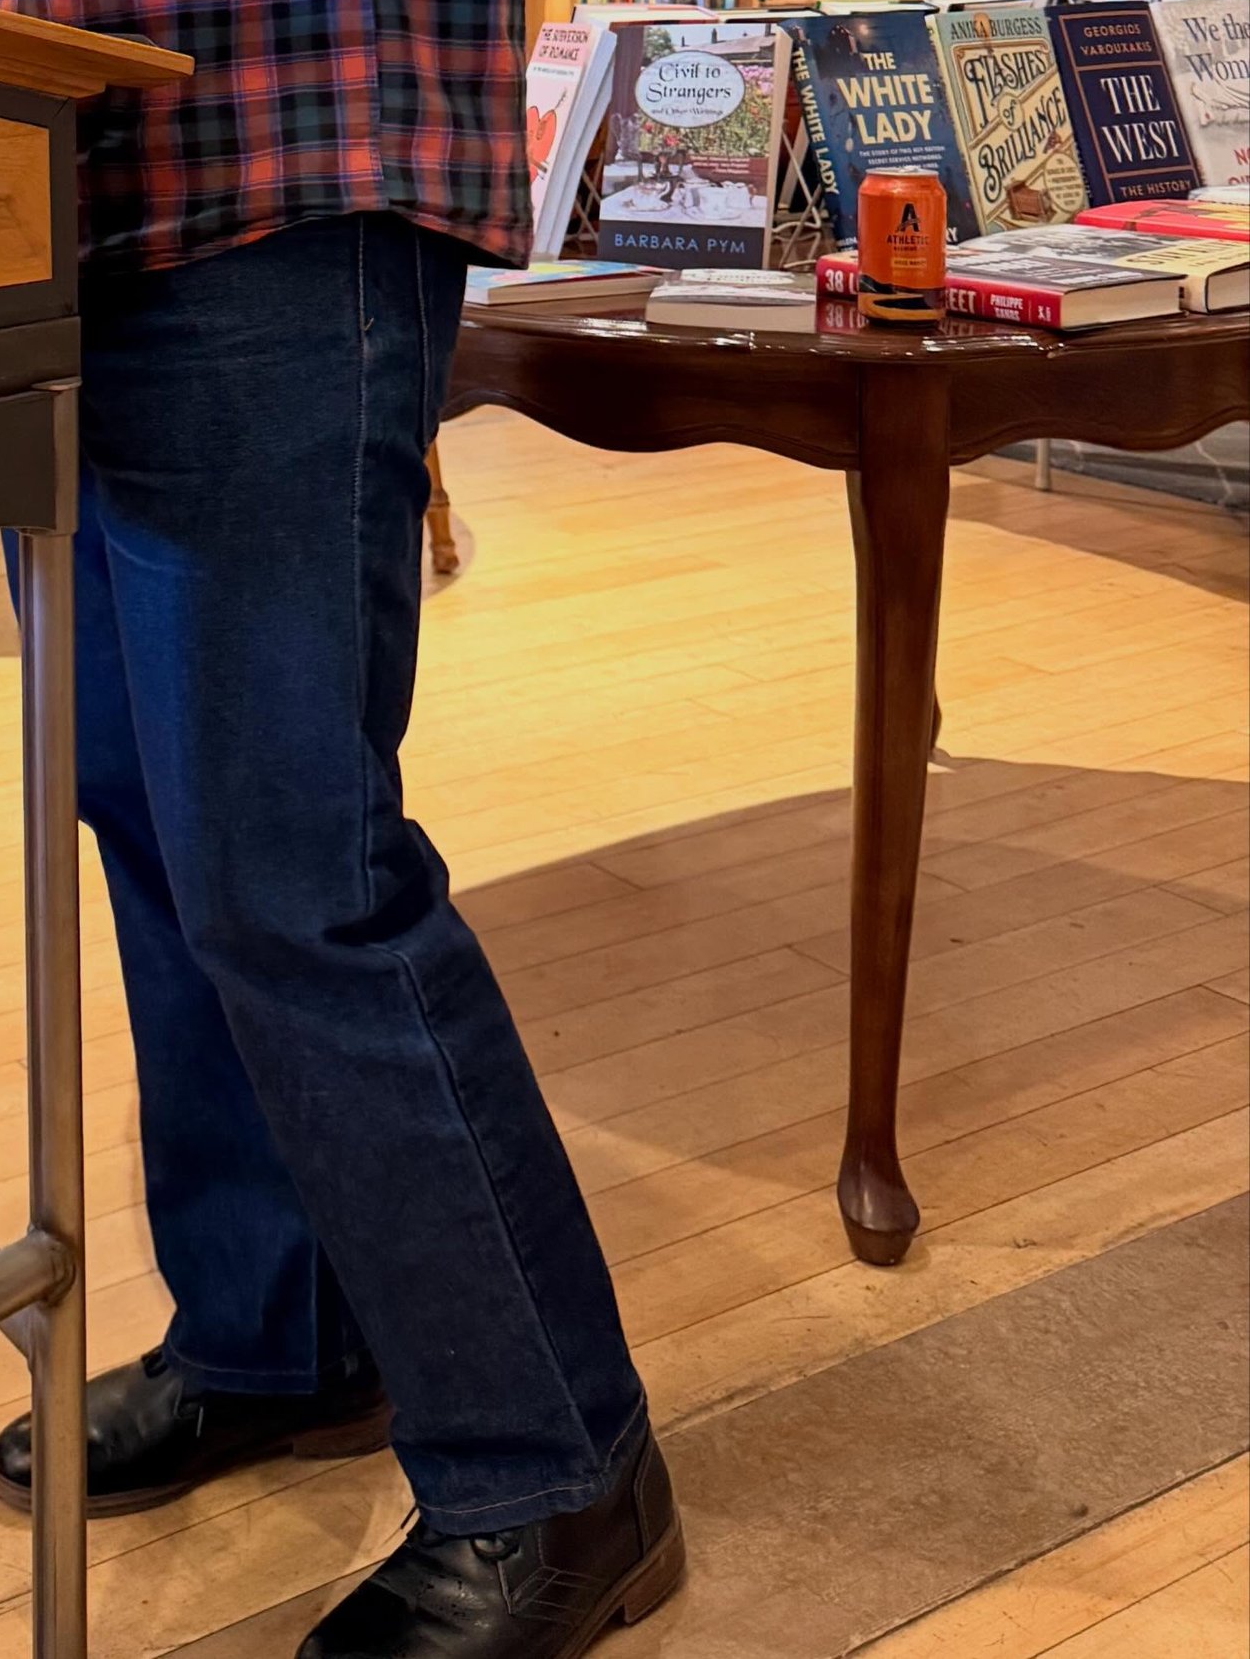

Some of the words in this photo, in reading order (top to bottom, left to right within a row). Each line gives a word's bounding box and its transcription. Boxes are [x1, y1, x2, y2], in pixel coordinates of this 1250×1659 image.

[950, 20, 987, 41] ANIKA
[989, 16, 1043, 38] BURGESS
[1083, 24, 1141, 38] GEORGIOS
[1182, 17, 1221, 42] We
[862, 51, 896, 71] THE
[1080, 41, 1152, 56] VAROUXAKIS
[659, 62, 699, 80] Civil
[705, 63, 721, 79] to
[793, 47, 810, 80] THE
[1183, 53, 1250, 82] Wom
[646, 83, 732, 105] Strangers
[837, 74, 935, 109] WHITE
[964, 49, 1050, 129] FLASHES
[1100, 74, 1161, 115] THE
[801, 85, 826, 143] WHITE
[1001, 99, 1019, 128] of
[856, 109, 932, 145] LADY
[978, 87, 1067, 204] BRILLIANCE
[1102, 120, 1183, 164] WEST
[815, 147, 840, 195] LADY
[1120, 185, 1143, 197] THE
[1148, 179, 1192, 195] HISTORY
[614, 233, 699, 251] BARBARA
[707, 238, 746, 254] PYM
[886, 235, 930, 245] ATHLETIC
[825, 268, 844, 293] 38
[990, 294, 1024, 310] PHILIPPE
